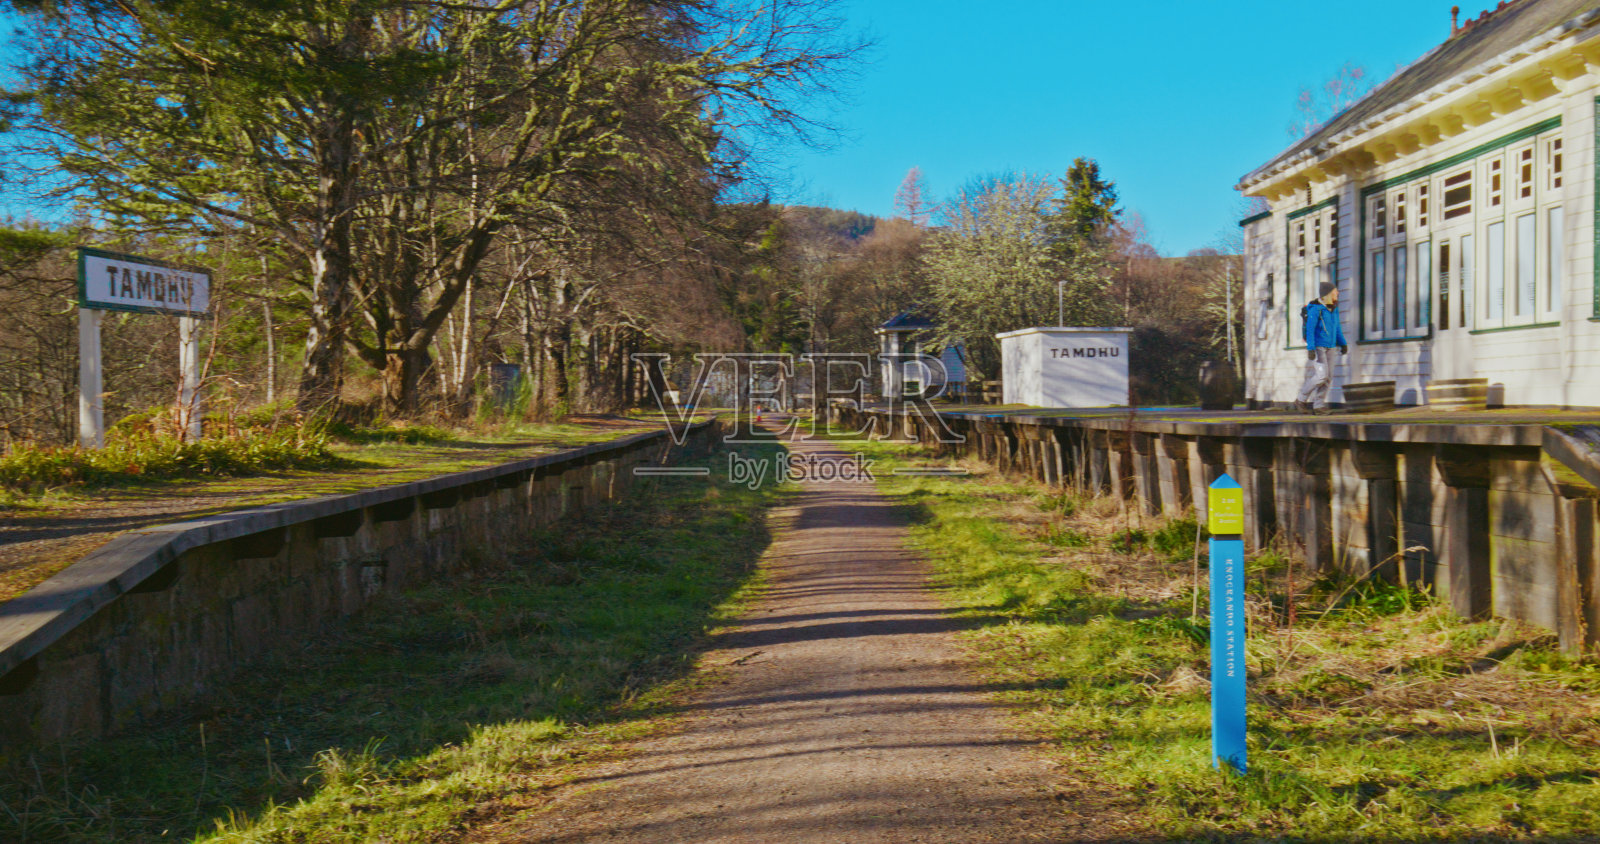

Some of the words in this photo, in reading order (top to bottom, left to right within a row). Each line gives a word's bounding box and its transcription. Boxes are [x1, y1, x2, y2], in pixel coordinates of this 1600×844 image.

[106, 265, 194, 304] TAMDHU
[1050, 347, 1119, 359] TAMDHU
[1225, 558, 1234, 627] KNOCKANDO
[1226, 630, 1235, 677] STATION
